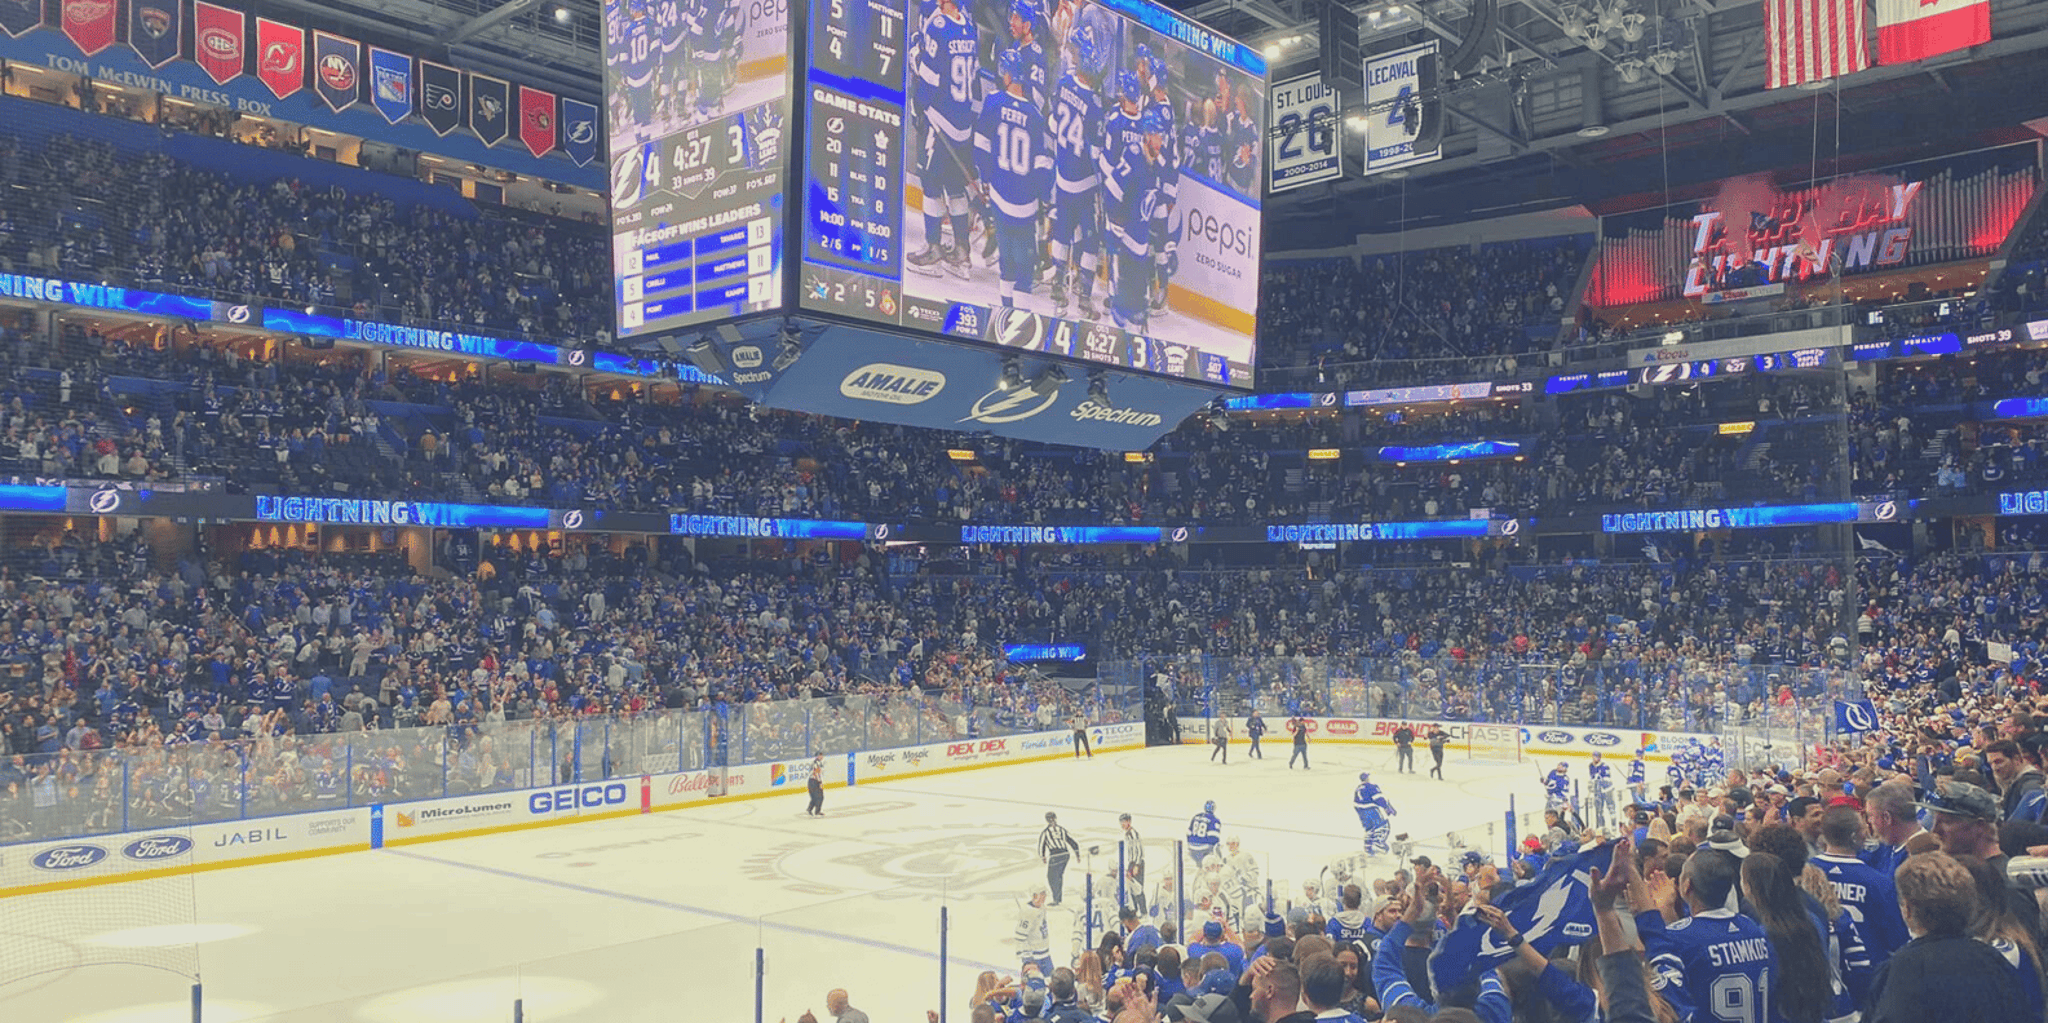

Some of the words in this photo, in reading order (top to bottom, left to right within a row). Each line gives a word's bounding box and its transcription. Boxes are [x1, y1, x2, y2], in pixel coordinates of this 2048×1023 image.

[831, 0, 843, 19] 5
[880, 14, 892, 39] 11
[630, 34, 648, 64] 10
[829, 36, 842, 60] 4
[879, 53, 891, 76] 7
[46, 53, 89, 76] TOM
[97, 65, 172, 94] McEWEN
[180, 84, 231, 107] PRESS
[237, 97, 272, 117] BOX
[1277, 90, 1294, 109] ST.
[1298, 83, 1332, 104] LOUIS
[813, 89, 857, 113] GAME
[858, 102, 901, 127] STATS
[1001, 106, 1028, 127] PERRY
[1057, 102, 1084, 157] 24
[1278, 104, 1334, 161] 26
[673, 135, 711, 171] 4:27
[728, 125, 743, 164] 3
[826, 137, 842, 155] 20
[997, 122, 1030, 175] 10
[645, 152, 660, 186] 4
[1284, 159, 1328, 177] 2000-2014
[874, 174, 887, 191] 10
[827, 186, 839, 202] 15
[875, 200, 884, 214] 8
[632, 226, 678, 247] FACEOFF
[678, 218, 708, 236] WINS
[708, 203, 761, 227] LEADERS
[1188, 208, 1252, 258] pepsi
[1196, 252, 1215, 268] ZERO
[1684, 227, 1911, 298] LIHTNNG
[69, 281, 126, 311] WIN
[834, 283, 845, 302] 2
[865, 289, 876, 308] 5
[343, 318, 454, 351] LIGHTNING
[457, 333, 497, 356] WIN
[1054, 321, 1071, 355] 4
[1086, 331, 1117, 354] 4:27
[1854, 341, 1891, 351] PENALTY
[1904, 336, 1943, 346] PENALTY
[1967, 333, 1997, 344] SHOTS
[1997, 329, 2012, 342] 39
[735, 348, 760, 362] AMALIE
[1133, 336, 1147, 368] 3
[1656, 349, 1689, 361] Coors
[1763, 357, 1773, 369] 3
[733, 371, 767, 385] Spectrum
[1701, 363, 1710, 375] 4
[847, 372, 940, 396] AMALIE
[1070, 400, 1161, 427] Spectrum
[256, 496, 409, 524] LIGHTNING
[415, 502, 466, 526] WIN
[1602, 509, 1720, 532] LIGHTNING
[670, 514, 772, 537] LIGHTNING
[777, 518, 813, 538] WIN
[962, 525, 1056, 543] LIGHTNING
[1060, 526, 1099, 543] WIN
[1267, 524, 1373, 542] LIGHTNING
[1104, 725, 1133, 734] TECO
[1450, 726, 1512, 742] CHASE
[1543, 731, 1568, 743] Ford
[1590, 733, 1615, 746] Ford
[867, 752, 895, 763] Mosaic
[902, 749, 928, 760] Mosaic
[947, 742, 975, 757] DEX
[979, 739, 1006, 752] DEX
[420, 801, 512, 819] MicroLumen
[529, 783, 627, 814] GEICO
[135, 838, 180, 858] Ford
[215, 828, 288, 847] JABIL
[45, 847, 93, 867] Ford
[1708, 937, 1769, 967] STAMKOS
[1710, 966, 1769, 1023] 91
